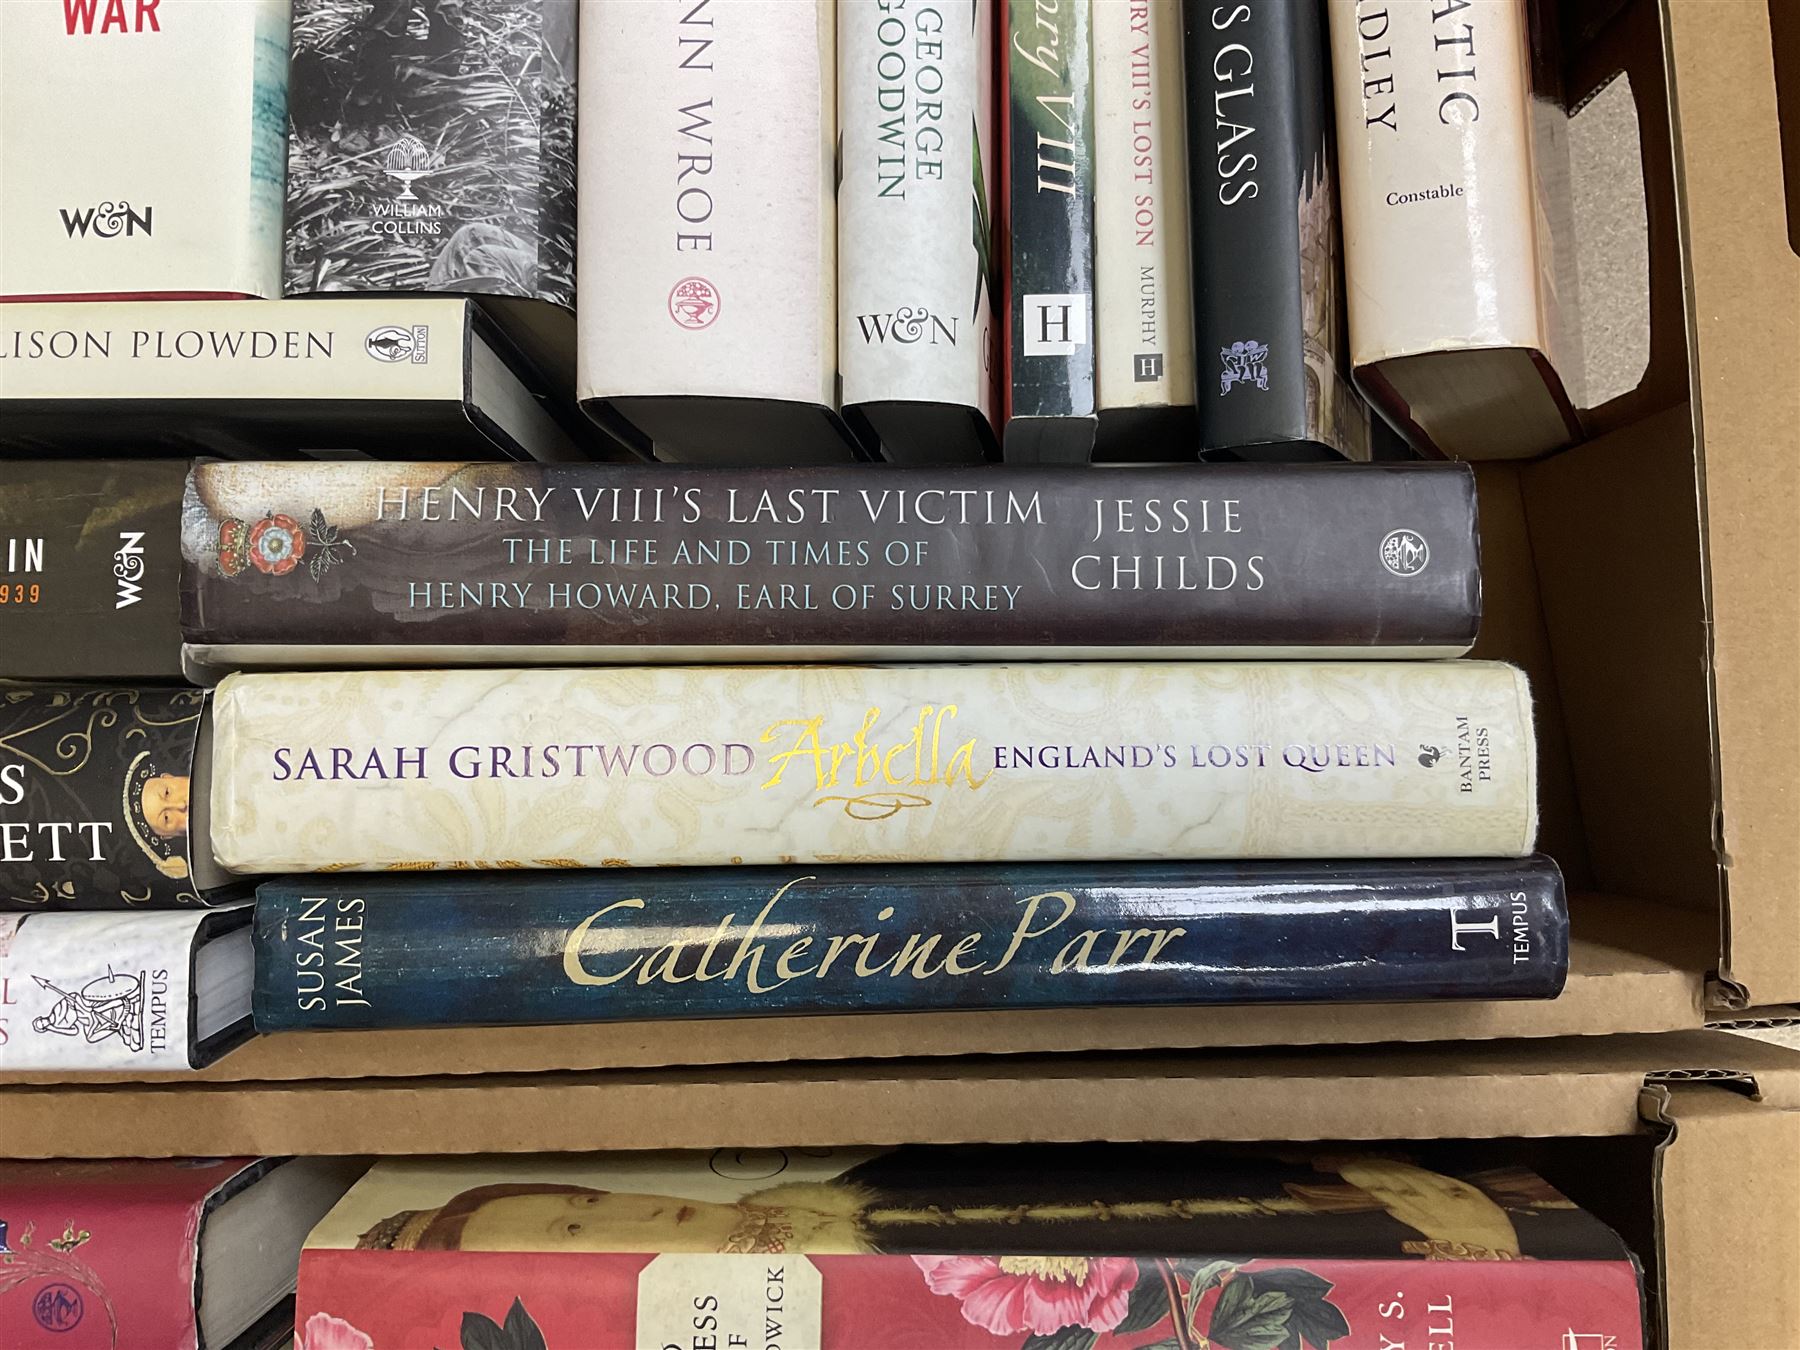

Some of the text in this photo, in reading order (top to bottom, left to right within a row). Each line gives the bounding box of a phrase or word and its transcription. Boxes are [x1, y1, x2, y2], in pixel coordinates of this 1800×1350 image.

[62, 0, 161, 35] WAR
[1356, 0, 1397, 132] DLEY
[915, 8, 943, 181] GEORGE
[1211, 5, 1259, 206] S GLASS
[1036, 92, 1077, 199] VIII
[677, 96, 714, 252] WROE
[1130, 0, 1155, 345] RY VIII'S LOST SON MURPHY
[372, 204, 441, 217] WILLIAM
[1386, 184, 1464, 206] Constable
[59, 201, 153, 238] W&N
[372, 221, 441, 235] COLLINS
[415, 327, 426, 361] SUTTON
[857, 306, 958, 346] W&N
[1037, 305, 1071, 342] H
[131, 330, 334, 360] PLOWDEN
[1140, 359, 1156, 376] H
[376, 485, 1046, 525] HENRY VIII'S LAST VICTIM
[1091, 498, 1243, 542] JESSIE
[113, 531, 146, 610] W&N
[502, 536, 930, 568] THE LIFE AND TIMES OF
[1070, 555, 1266, 592] CHILDS
[408, 579, 1023, 612] HENRY HOWARD, EARL OF SURREY
[272, 743, 756, 782] SARAH GRISTWOOD
[759, 704, 994, 792] Arbella
[994, 744, 1396, 773] ENGLAND'S LOST QUEEN
[1456, 716, 1472, 793] BANTAM
[1476, 727, 1491, 782] PRESS
[0, 821, 113, 862] ETT
[562, 876, 1186, 994] Catherine Parr
[1450, 905, 1500, 952] T
[1510, 891, 1530, 965] TEMPUS
[297, 896, 328, 1012] SUSAN
[336, 897, 371, 1009] JAMES
[150, 969, 168, 1054] TEMPUS
[1378, 1291, 1405, 1320] S.
